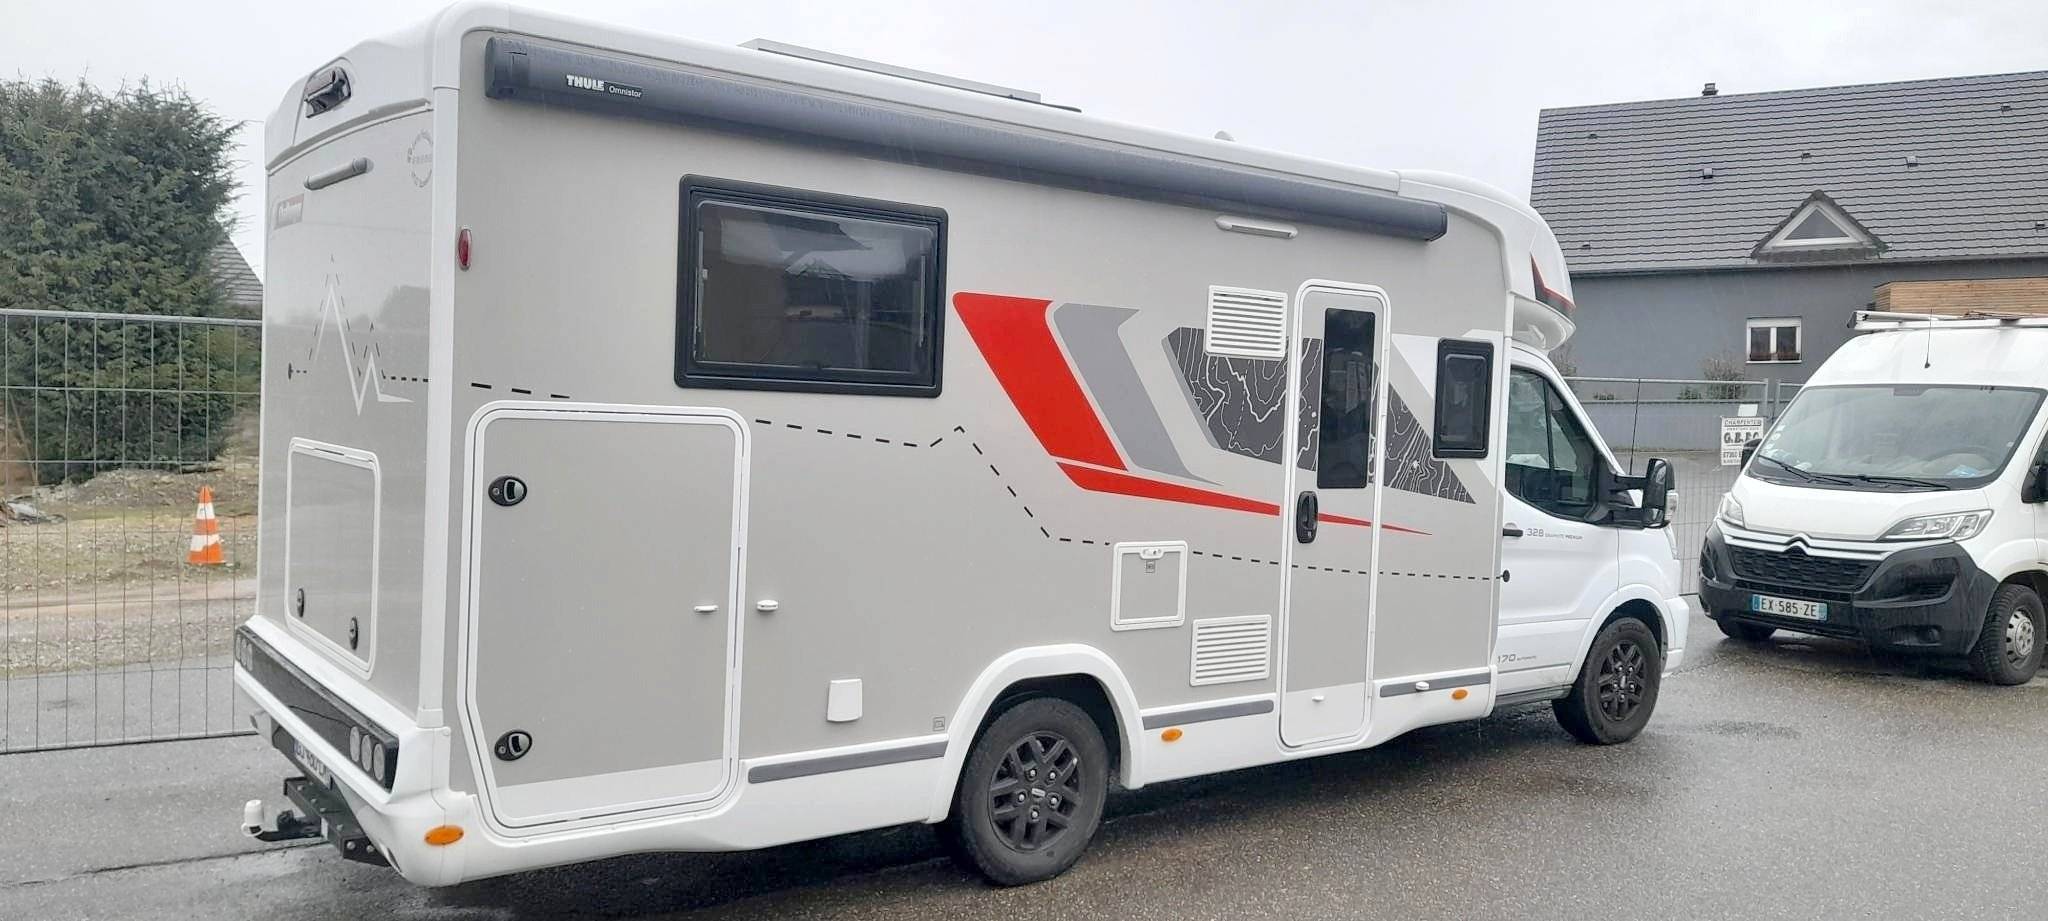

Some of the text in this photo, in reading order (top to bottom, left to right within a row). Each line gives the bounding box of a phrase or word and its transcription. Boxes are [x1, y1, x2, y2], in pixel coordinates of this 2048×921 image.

[566, 74, 642, 98] THULE Omnistor
[1526, 528, 1544, 538] 328
